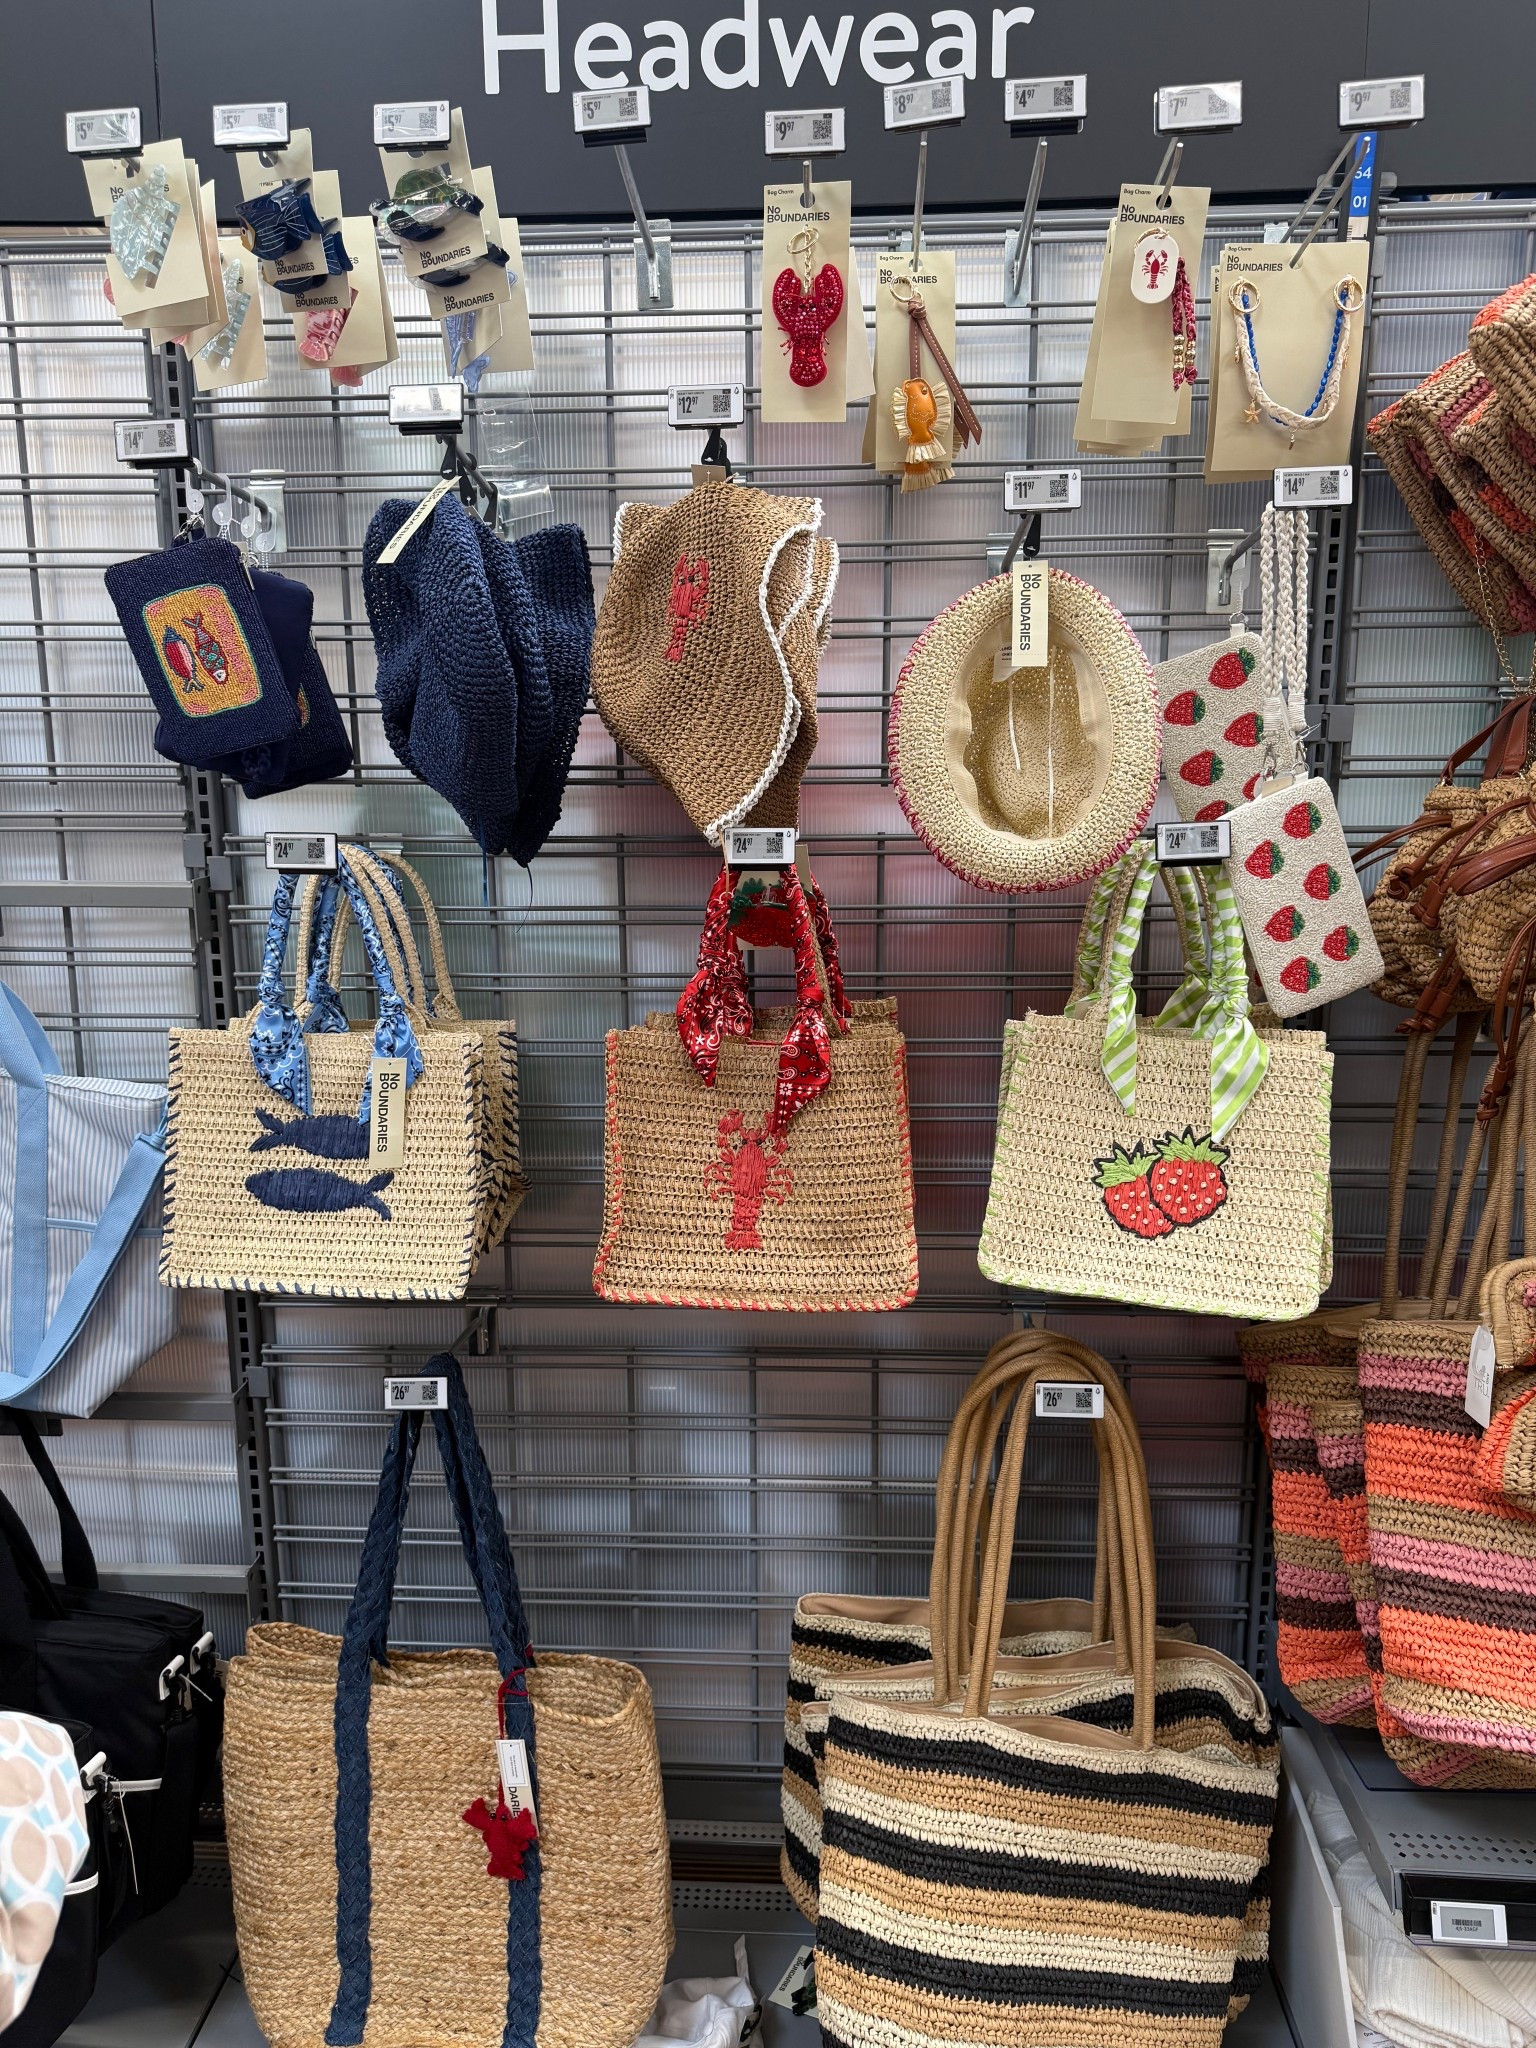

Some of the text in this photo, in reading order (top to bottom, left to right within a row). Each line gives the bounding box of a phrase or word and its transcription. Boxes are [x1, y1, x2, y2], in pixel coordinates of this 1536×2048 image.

[482, 0, 1034, 94] Headwear
[1353, 195, 1367, 208] 01
[1031, 573, 1042, 589] NO
[1020, 574, 1031, 651] BOUNDARIES
[390, 1073, 400, 1089] NO
[377, 1073, 389, 1153] BOUNDARIES
